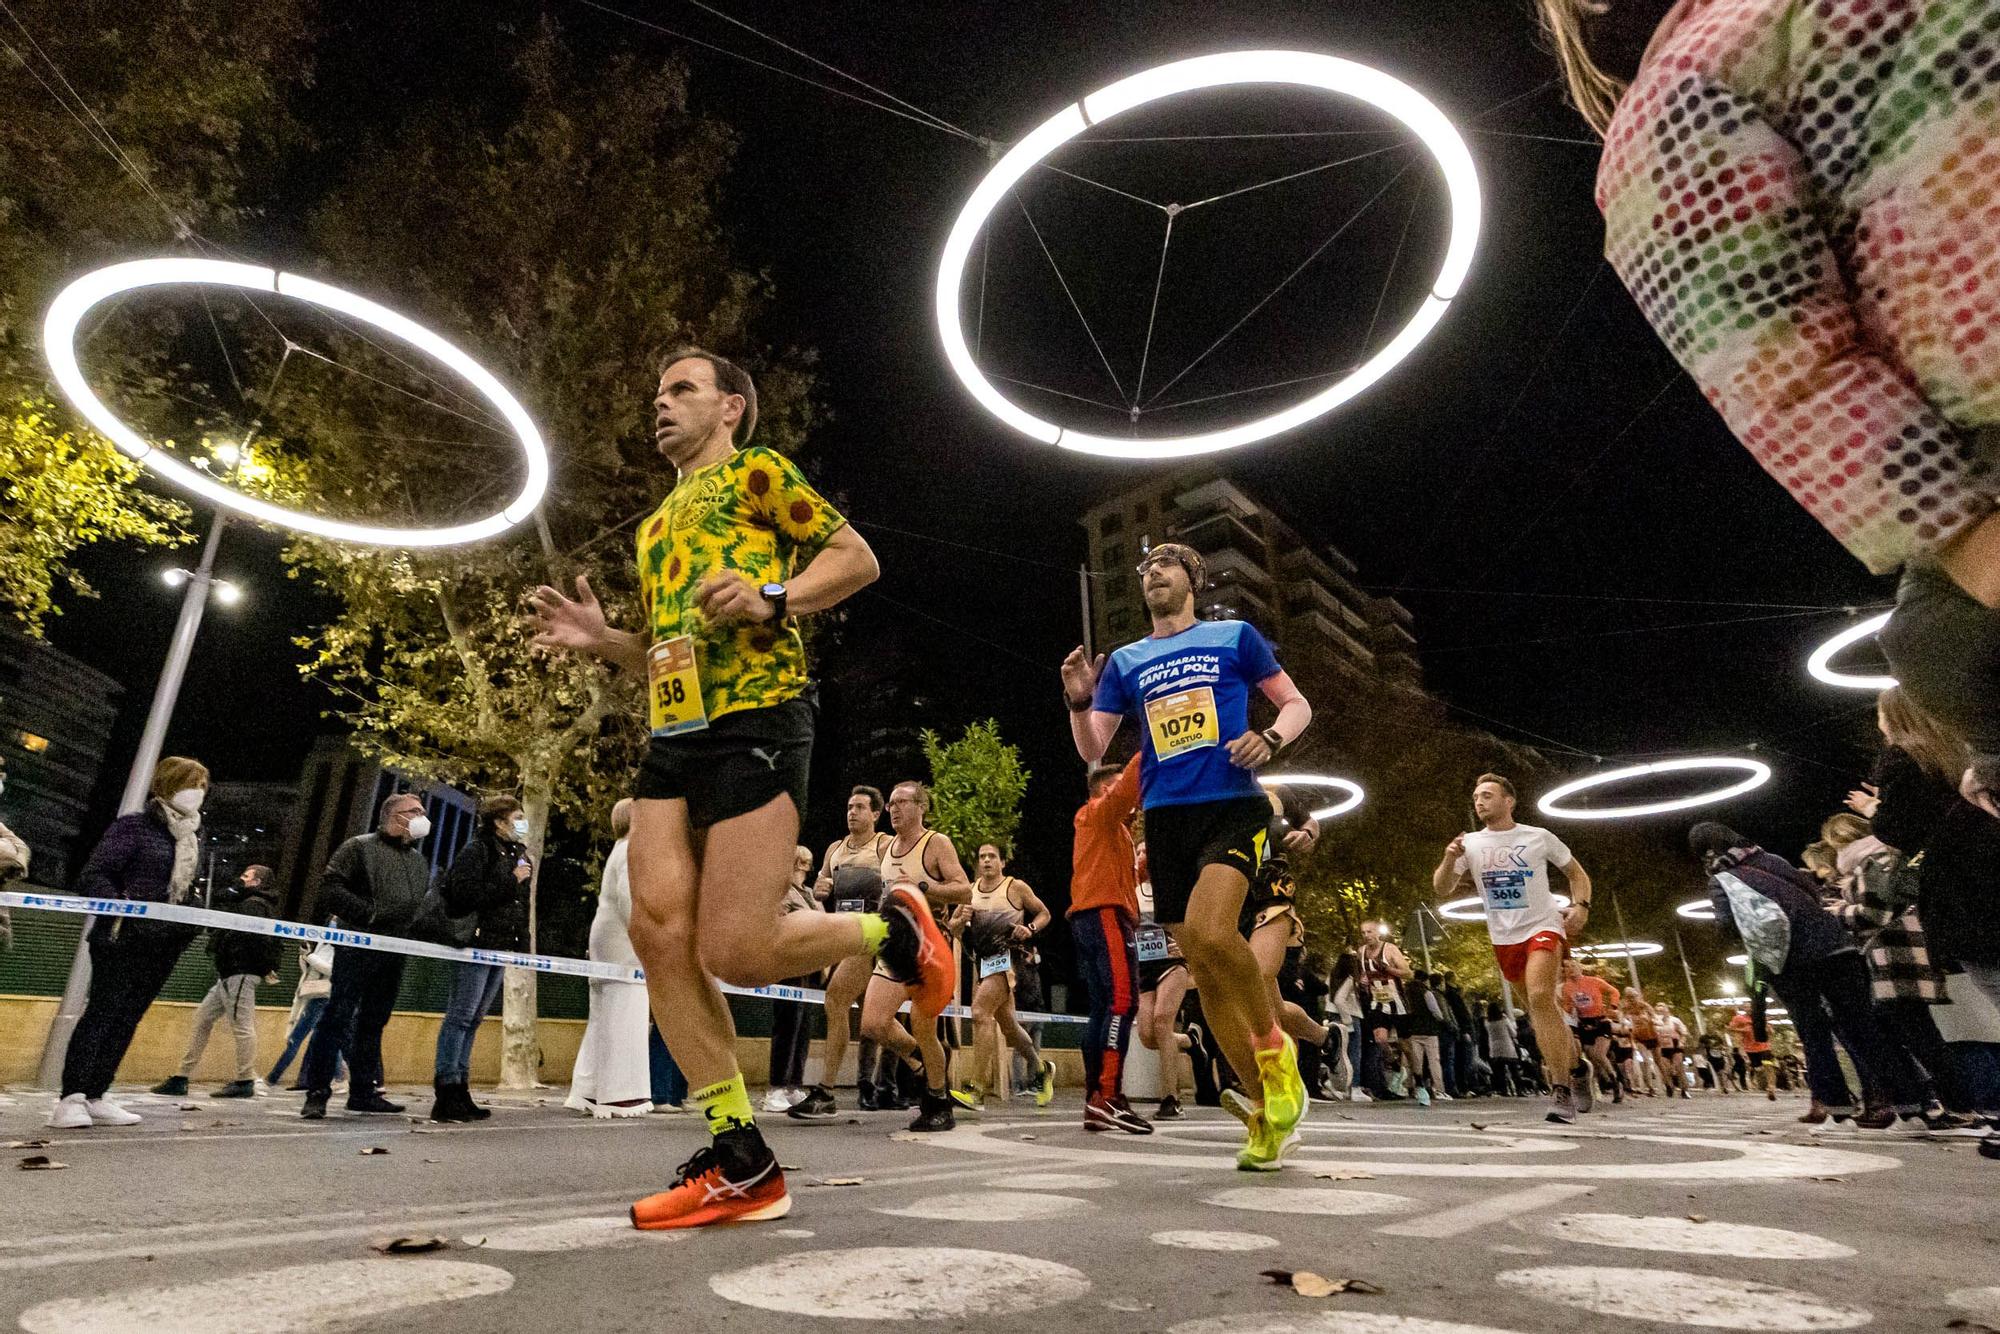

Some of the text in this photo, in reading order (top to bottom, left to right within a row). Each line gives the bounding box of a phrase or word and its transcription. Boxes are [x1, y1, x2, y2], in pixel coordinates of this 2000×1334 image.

[1166, 655, 1219, 669] MARATÓN
[1139, 667, 1180, 689] SANTA
[1183, 663, 1220, 674] POLA
[1160, 711, 1206, 739] 1079
[1169, 732, 1203, 748] CASTUO
[1491, 888, 1522, 900] 3616
[1139, 941, 1163, 952] 2400
